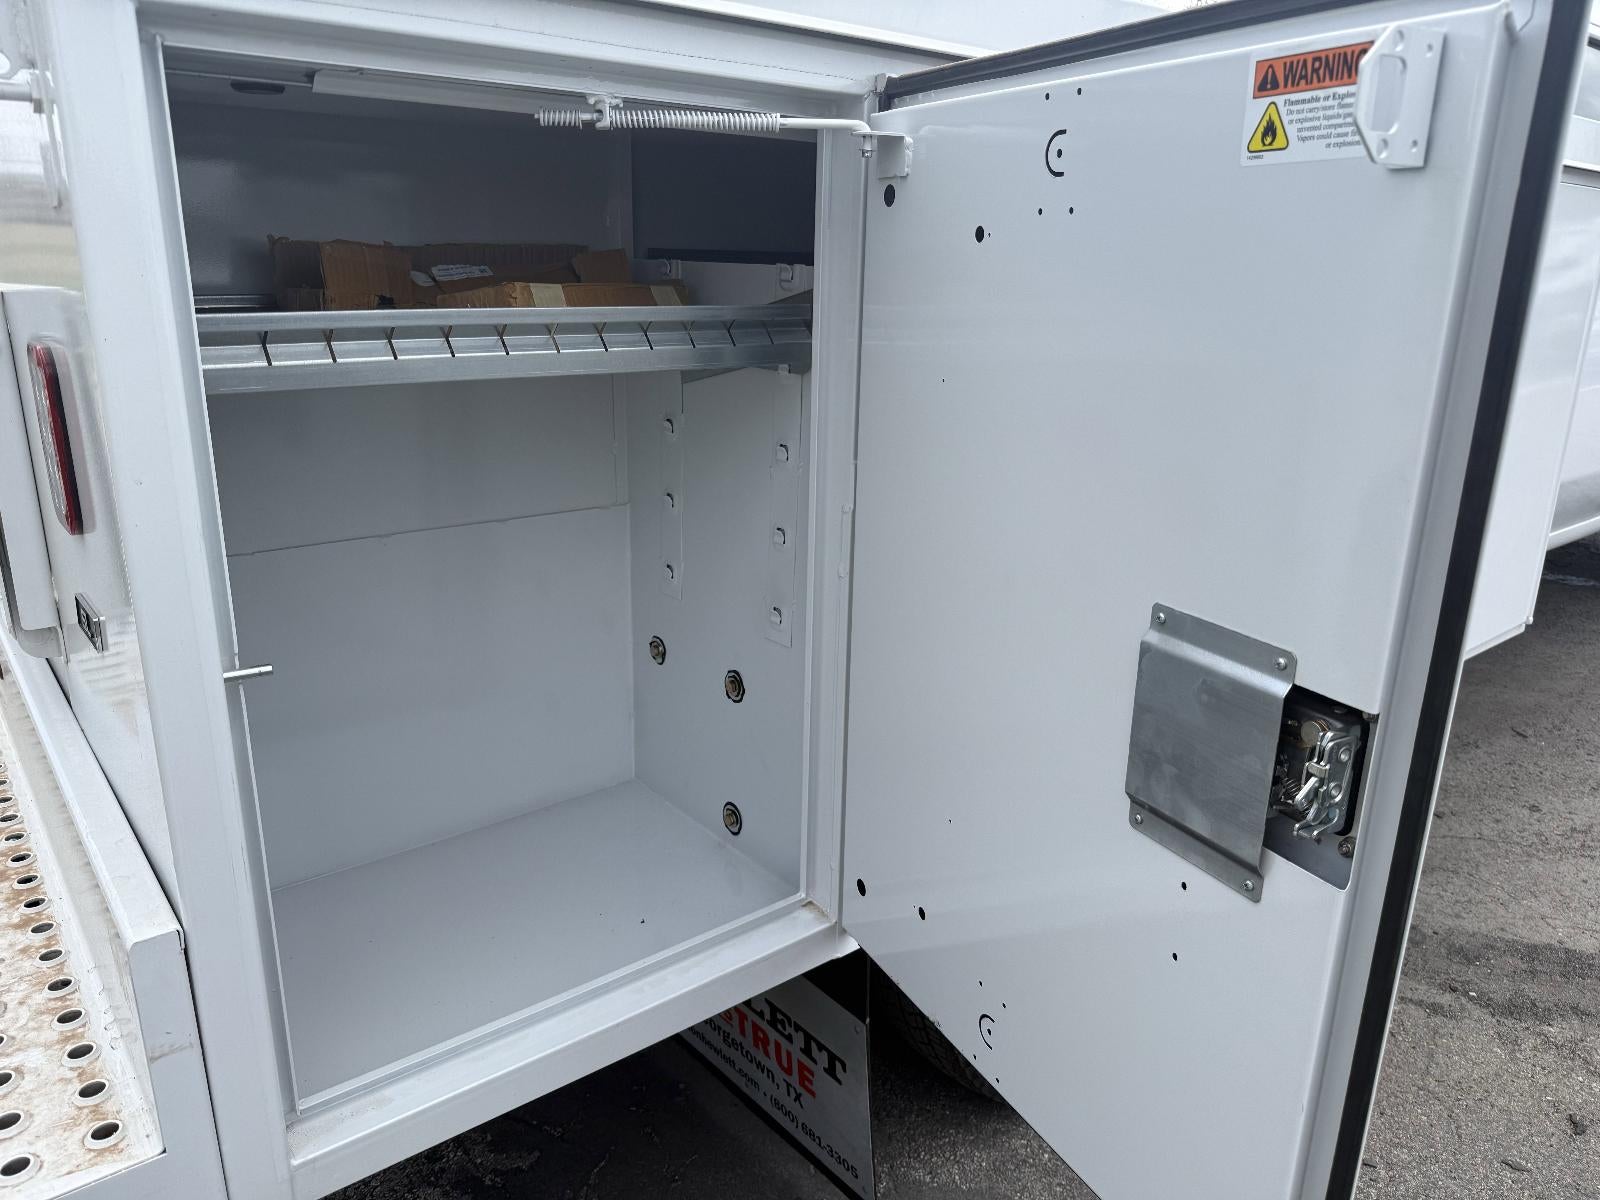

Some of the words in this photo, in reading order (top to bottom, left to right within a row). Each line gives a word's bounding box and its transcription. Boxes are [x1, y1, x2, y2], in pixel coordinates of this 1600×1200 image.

[1284, 95, 1321, 108] Flammable
[1286, 108, 1294, 116] Do
[1296, 107, 1305, 115] not
[1295, 115, 1321, 125] explosive
[1297, 135, 1315, 143] Vapors
[1316, 132, 1332, 140] could
[783, 1077, 804, 1108] TX
[770, 1095, 798, 1129] (800)
[801, 1122, 859, 1180] 681-3305
